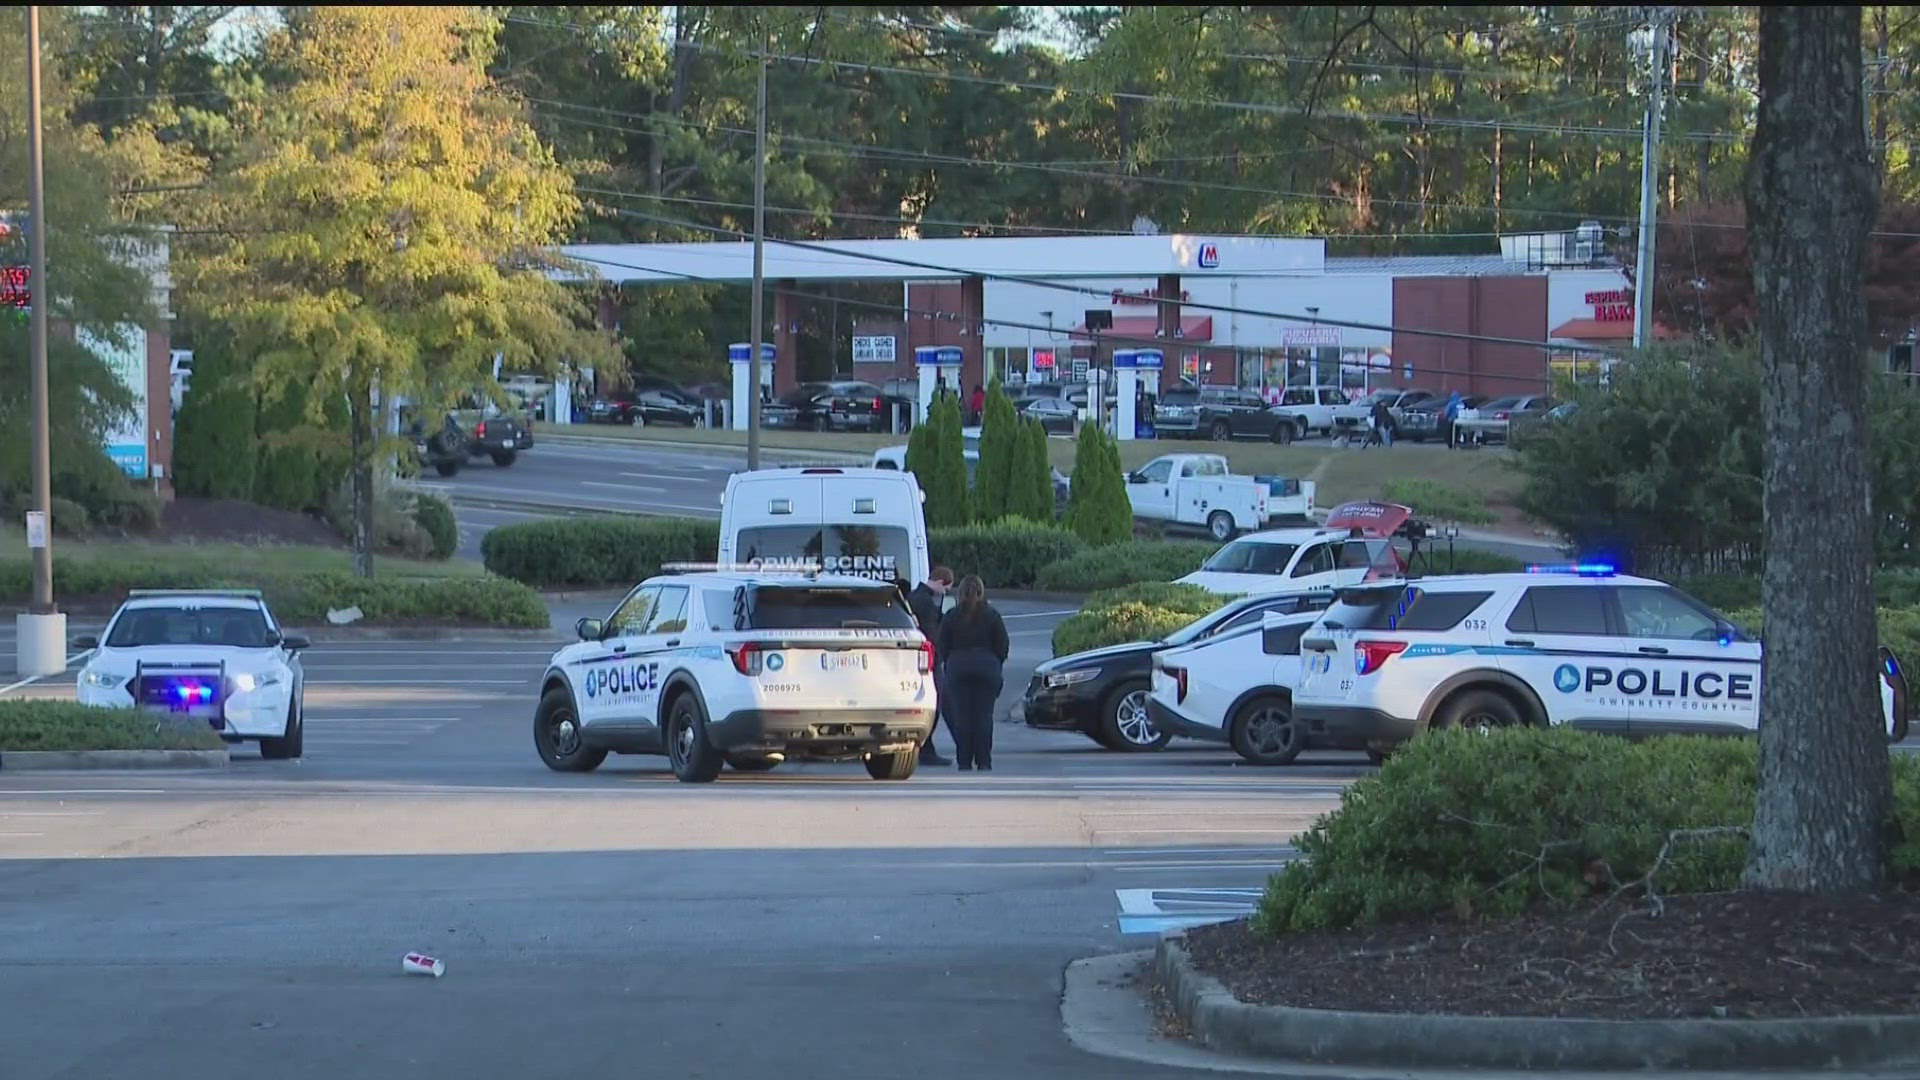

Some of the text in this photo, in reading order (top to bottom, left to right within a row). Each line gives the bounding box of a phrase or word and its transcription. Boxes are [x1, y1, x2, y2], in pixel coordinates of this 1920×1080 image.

[824, 555, 896, 570] SCENE
[1465, 619, 1487, 631] 032
[598, 661, 660, 697] POLICE
[1340, 679, 1354, 691] 032
[1585, 665, 1753, 700] POLICE
[1599, 697, 1738, 712] GWINNETT COUNTY
